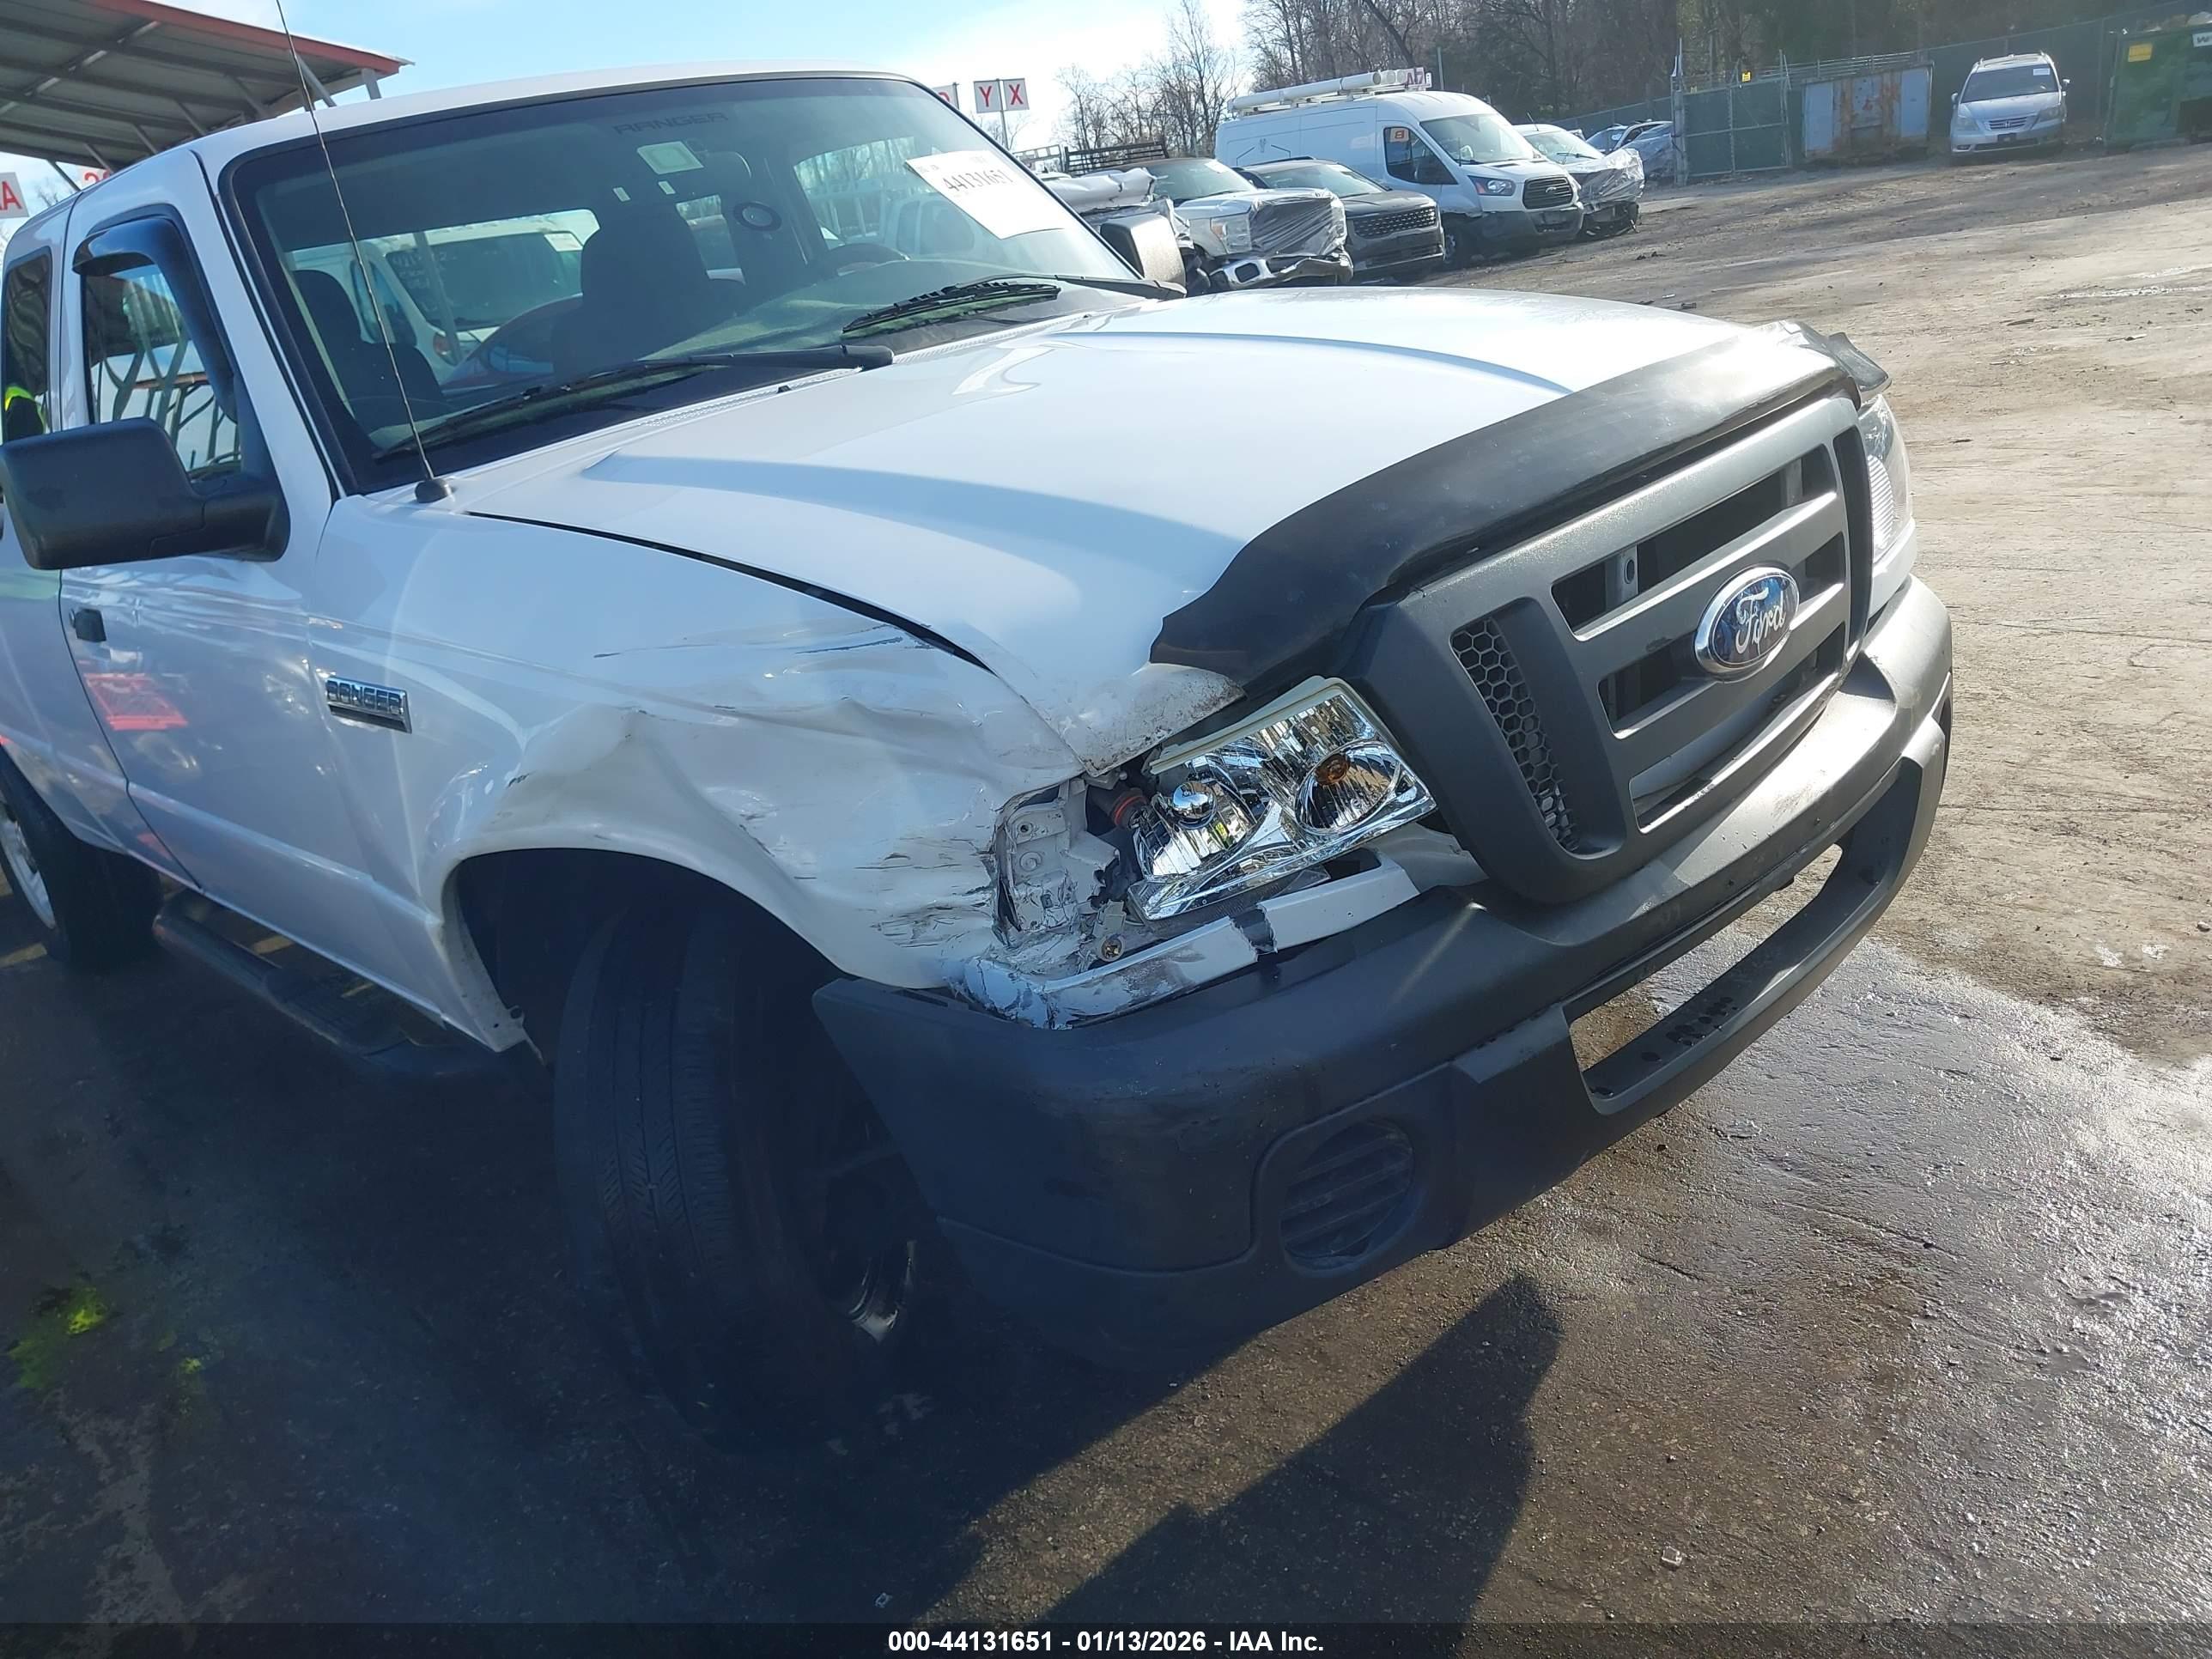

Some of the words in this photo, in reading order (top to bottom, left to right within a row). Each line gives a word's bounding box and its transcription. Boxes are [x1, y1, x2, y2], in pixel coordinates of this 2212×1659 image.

[979, 85, 993, 108] Y
[1008, 83, 1024, 106] X
[611, 112, 729, 136] RANGER
[1735, 586, 1787, 656] Ford
[325, 678, 405, 716] RANGER
